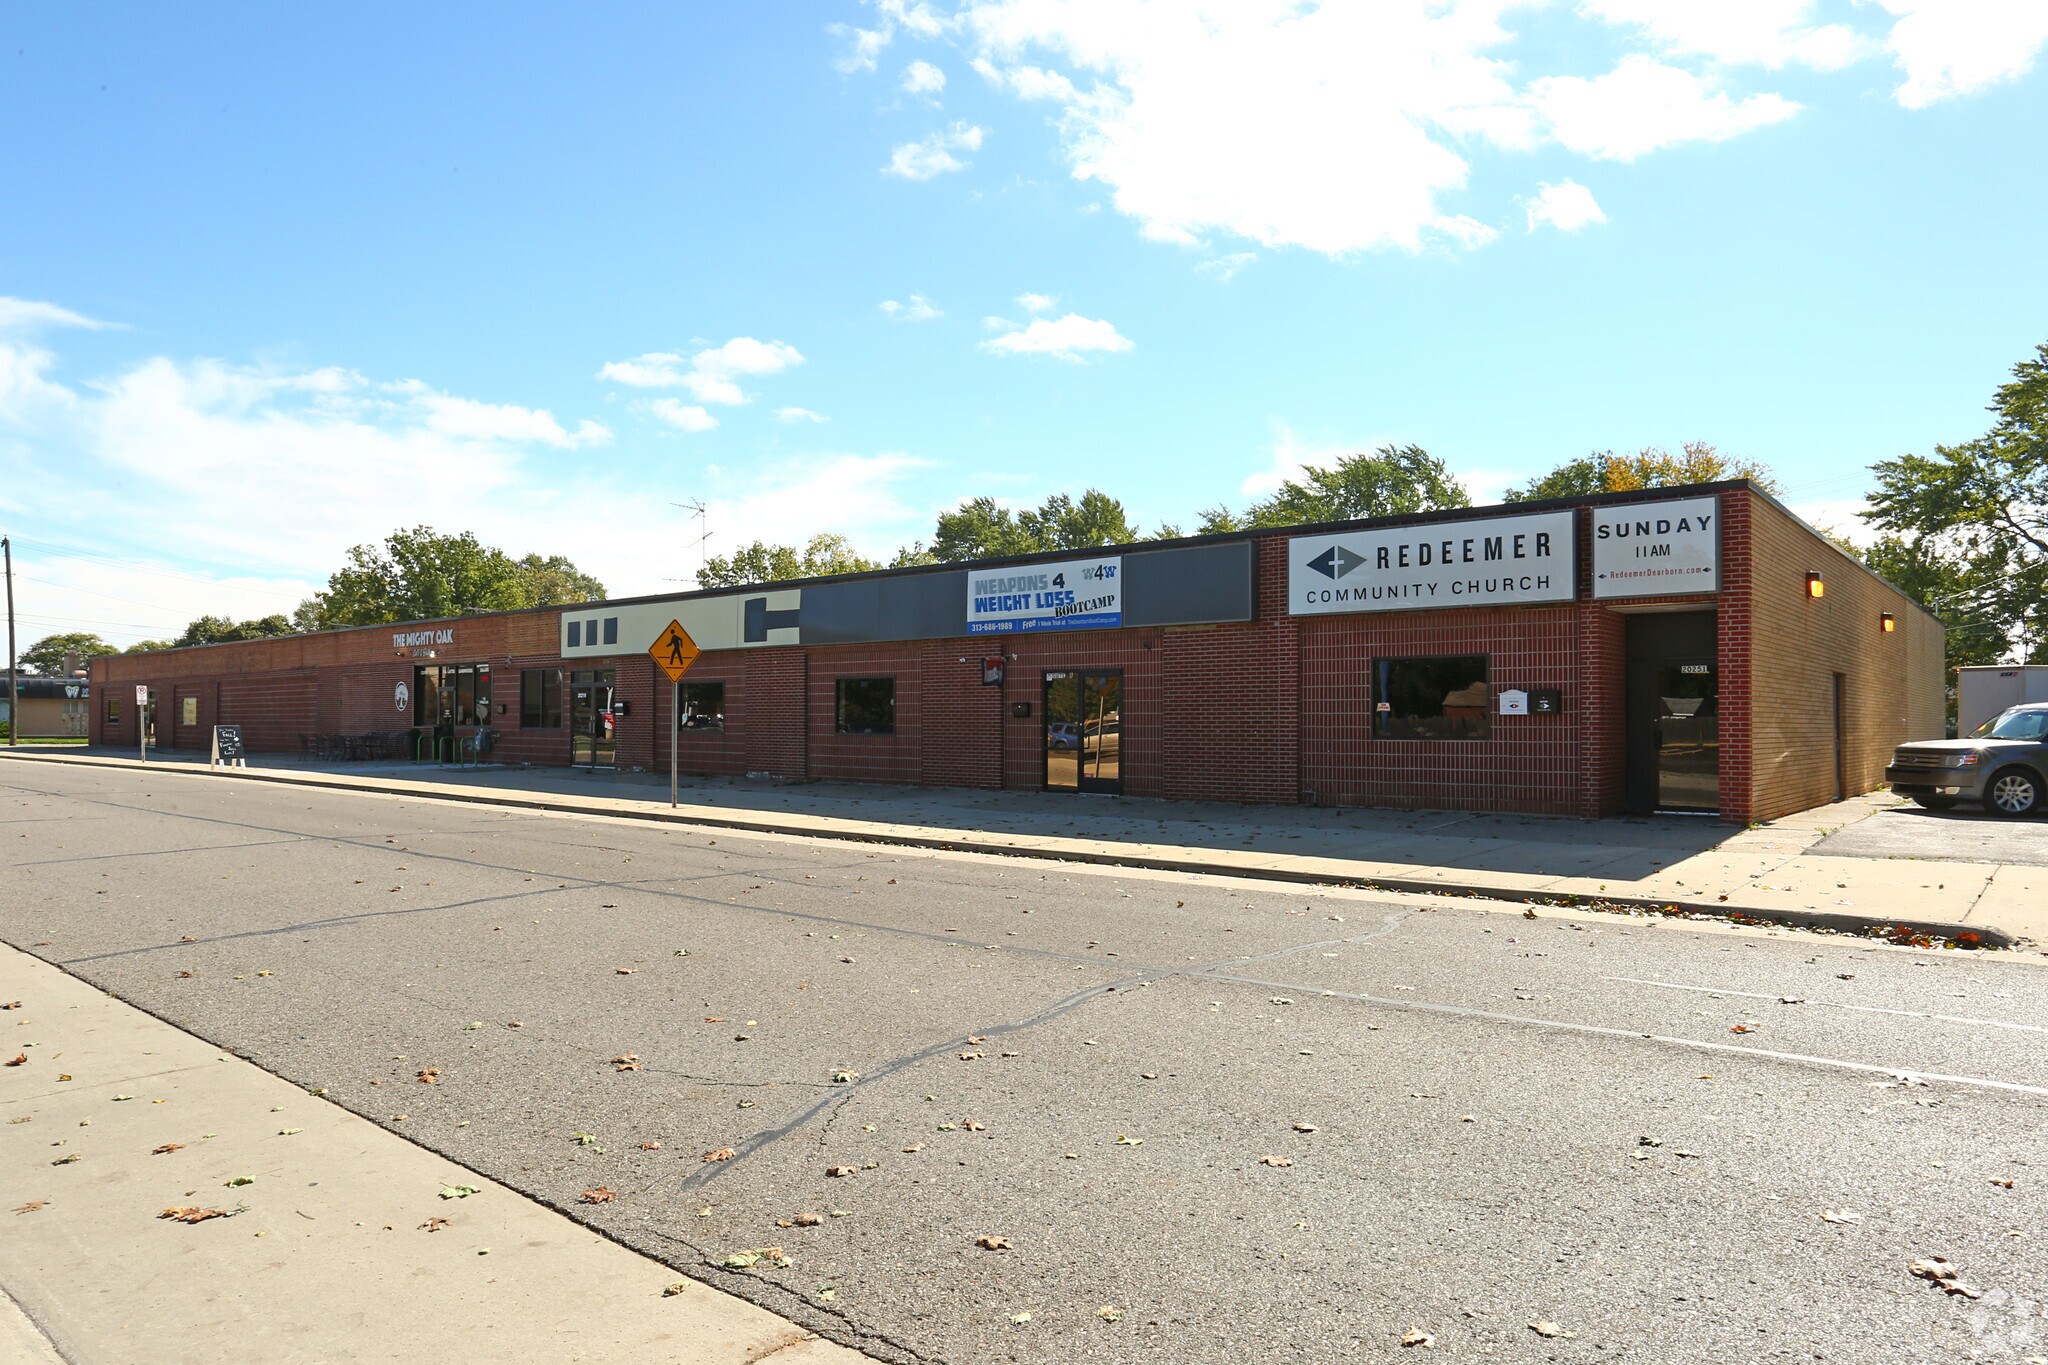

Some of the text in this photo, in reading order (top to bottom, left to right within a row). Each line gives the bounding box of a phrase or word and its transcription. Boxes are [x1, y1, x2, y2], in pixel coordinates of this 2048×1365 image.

[1597, 515, 1712, 540] SUNDAY
[1377, 532, 1551, 569] REDEEMER
[975, 572, 1065, 596] WEAPONS 4
[1610, 566, 1702, 579] RedeemerDearborn.com
[1306, 575, 1550, 604] COMMUNITY CHURCH
[974, 590, 1075, 613] WEIGHT LOSS
[1055, 594, 1115, 618] BOOTCAMP
[971, 622, 1013, 632] 313-686-1989
[1022, 619, 1036, 630] Free
[393, 629, 453, 647] THE MIGHTY OAK
[1682, 665, 1707, 673] 20251
